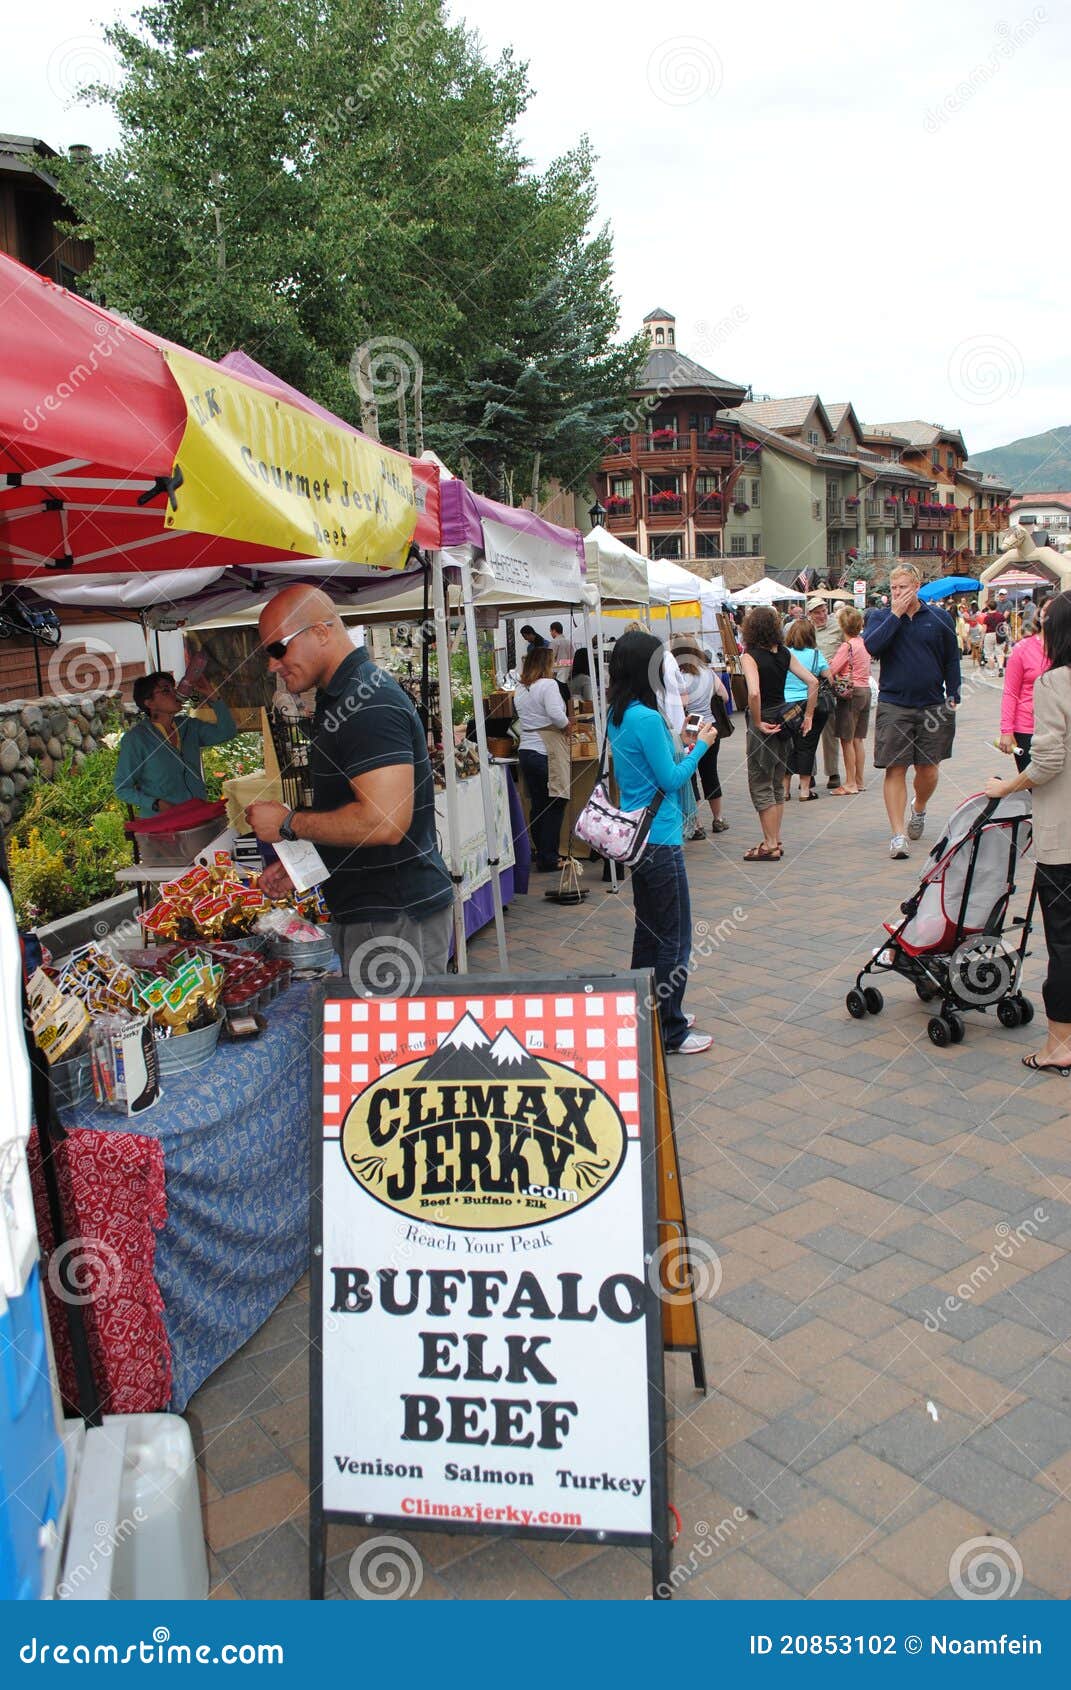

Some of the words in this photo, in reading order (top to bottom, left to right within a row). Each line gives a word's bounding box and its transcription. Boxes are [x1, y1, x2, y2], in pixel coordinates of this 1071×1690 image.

[240, 445, 332, 504] Gourmet
[340, 479, 389, 521] Jerky
[373, 1047, 399, 1067] High
[400, 1036, 438, 1056] Protein
[528, 1034, 549, 1050] Low
[366, 1084, 598, 1156] CLIMAX
[386, 1118, 575, 1201] JERKY
[420, 1196, 452, 1208] Beef
[463, 1195, 512, 1207] Buffalo
[526, 1198, 547, 1210] Elk
[521, 1183, 579, 1203] .com
[404, 1224, 457, 1253] Reach
[464, 1235, 506, 1254] Your
[511, 1231, 553, 1252] Peak
[329, 1266, 647, 1324] BUFFALO
[417, 1331, 558, 1385] ELK
[399, 1393, 579, 1450] BEEF
[333, 1455, 424, 1479] Venison
[444, 1463, 535, 1486] Salmon
[555, 1469, 647, 1497] Turkey
[400, 1497, 583, 1526] Climaxjerky.com
